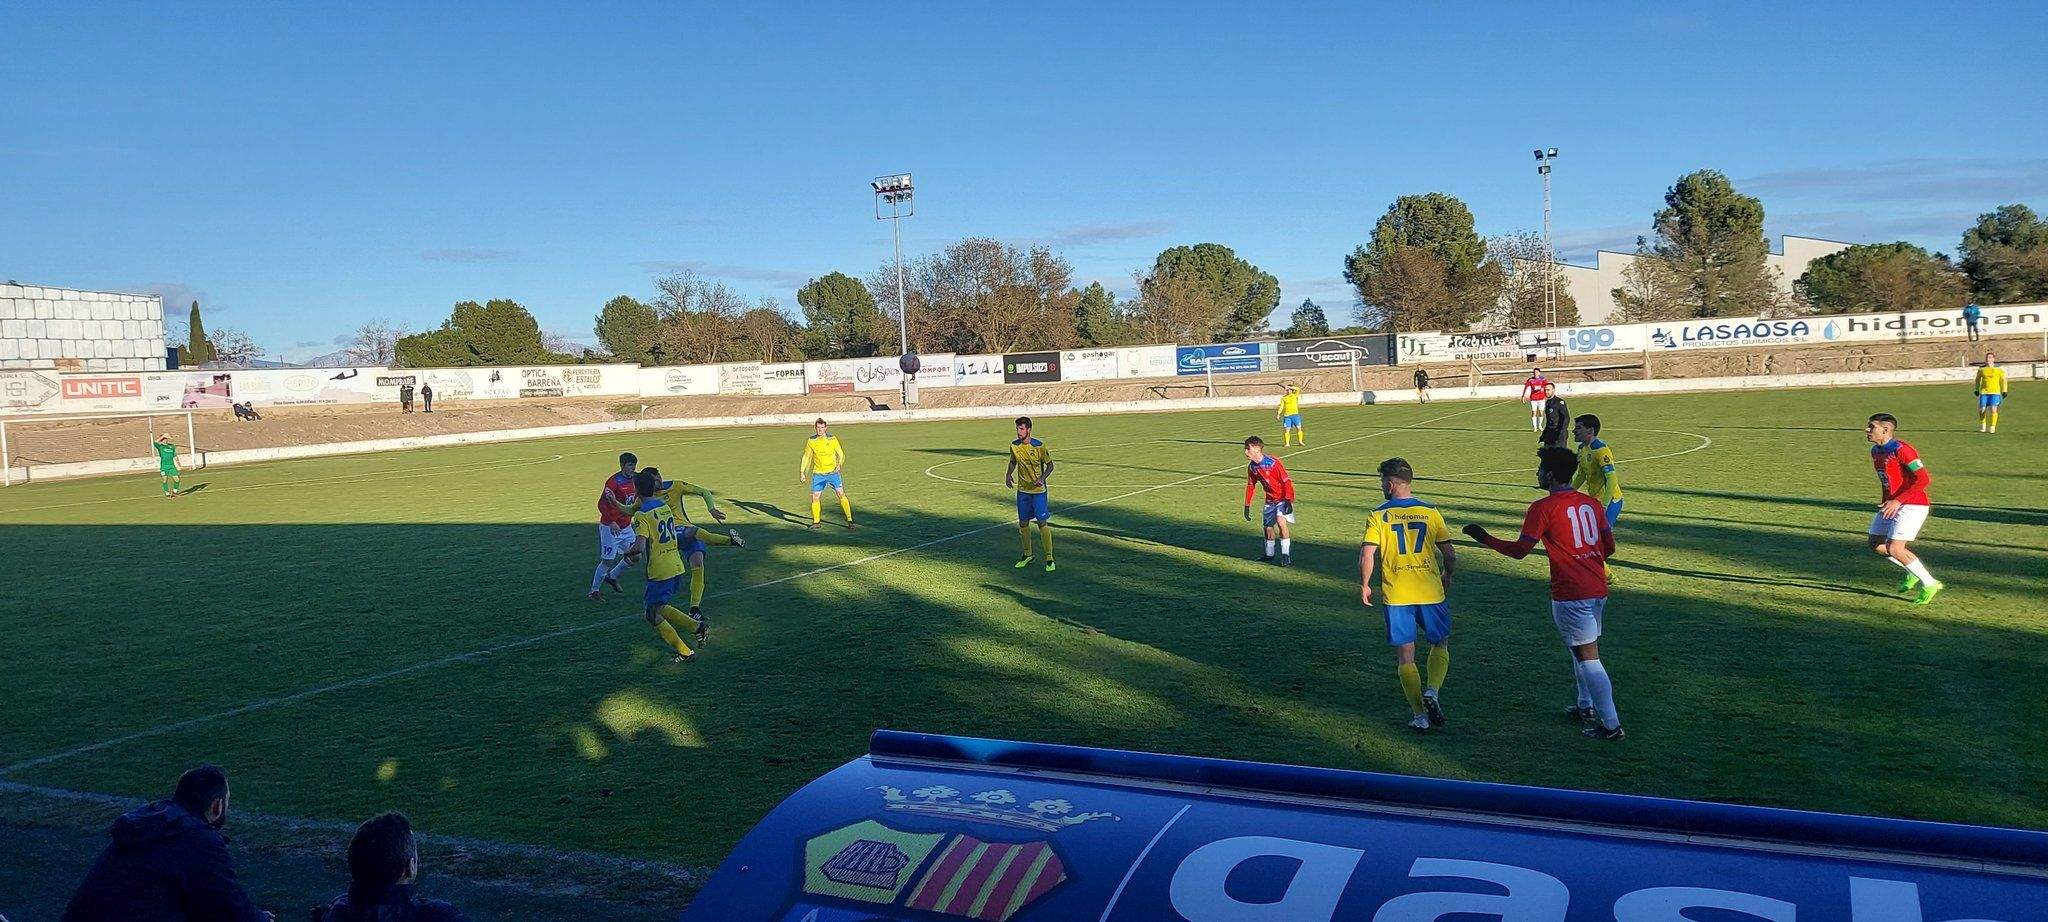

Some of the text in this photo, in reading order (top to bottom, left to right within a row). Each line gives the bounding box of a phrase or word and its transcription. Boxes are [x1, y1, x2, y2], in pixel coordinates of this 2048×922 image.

[1682, 321, 1810, 342] LASAOSA
[1567, 329, 1615, 353] igo
[1682, 340, 1739, 348] PRODUCTOS
[1454, 351, 1511, 360] ALMUDEVAR
[66, 381, 137, 396] UNITIC
[1394, 513, 1430, 521] hidroman
[1566, 503, 1599, 549] 10
[1390, 521, 1428, 555] 17
[603, 545, 613, 556] 19
